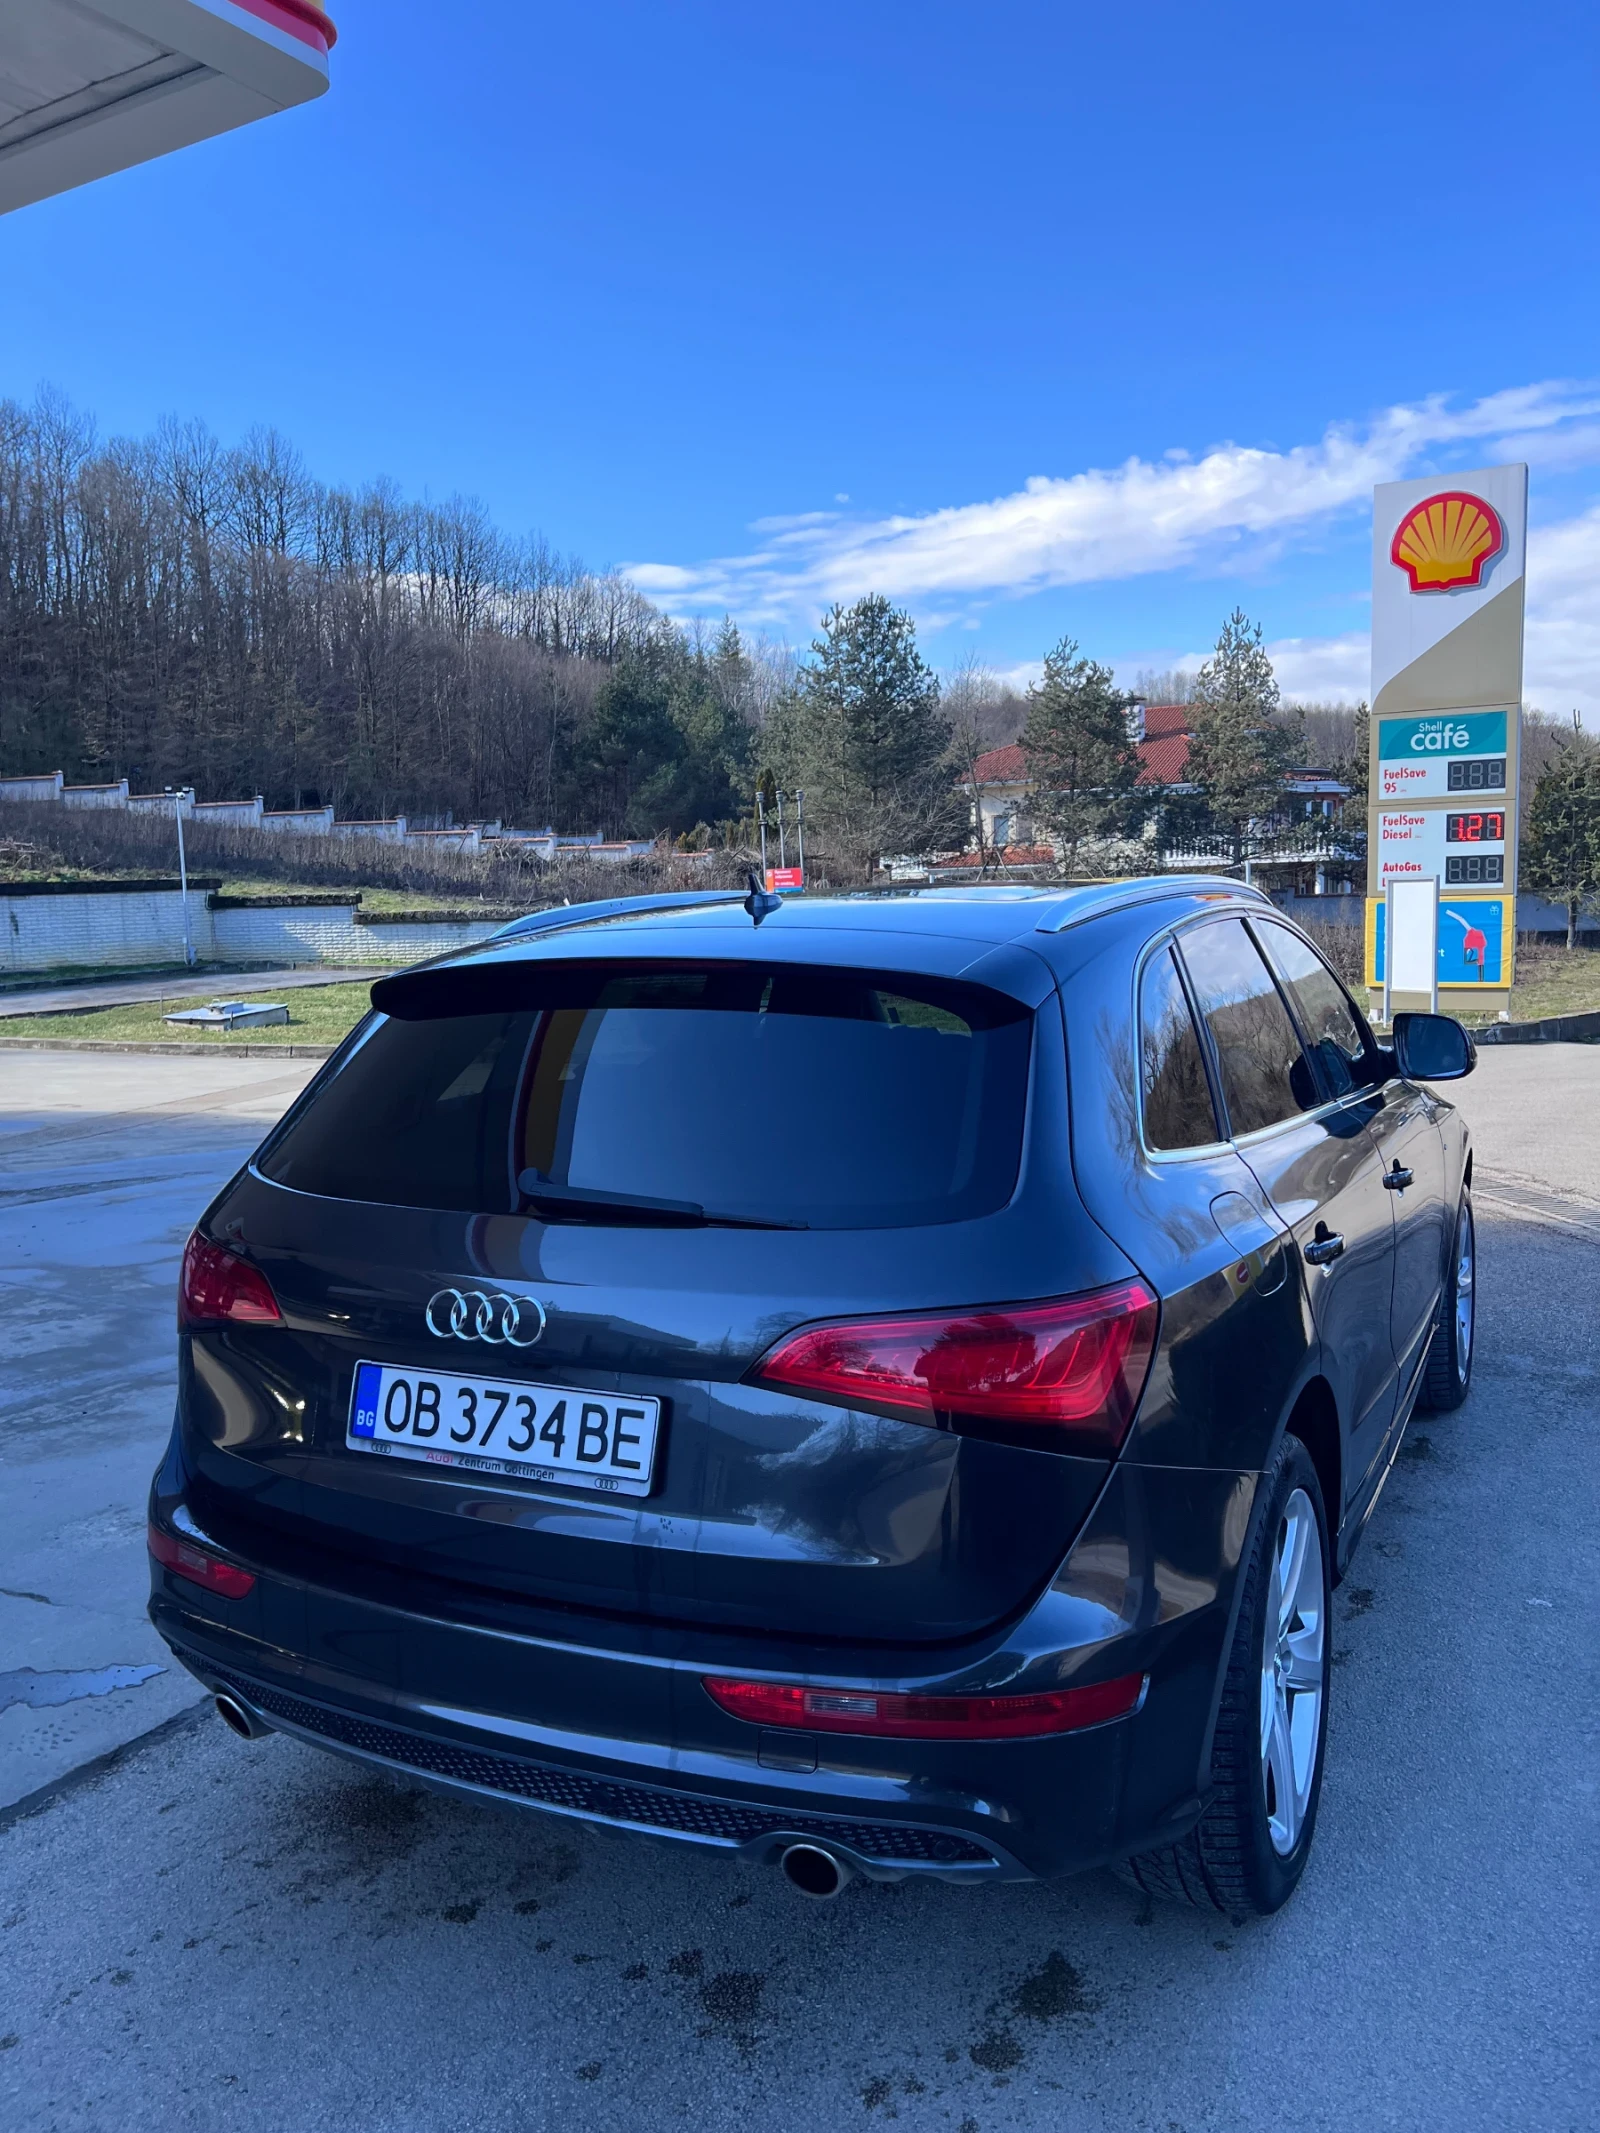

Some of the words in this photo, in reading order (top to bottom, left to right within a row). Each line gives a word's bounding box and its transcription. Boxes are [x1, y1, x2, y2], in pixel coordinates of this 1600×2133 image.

[1418, 721, 1442, 732] Shell
[1410, 723, 1470, 751] café
[1384, 767, 1427, 779] FuelSave
[1384, 782, 1397, 793] 95
[1383, 814, 1425, 826] FuelSave
[1383, 827, 1412, 839] Diesel
[1383, 862, 1422, 873] AutoGas
[356, 1409, 374, 1428] BG
[384, 1378, 441, 1438] OB
[450, 1387, 567, 1458] 3734
[576, 1402, 645, 1470] BE
[426, 1452, 453, 1464] Audi
[458, 1456, 501, 1472] Zentrum
